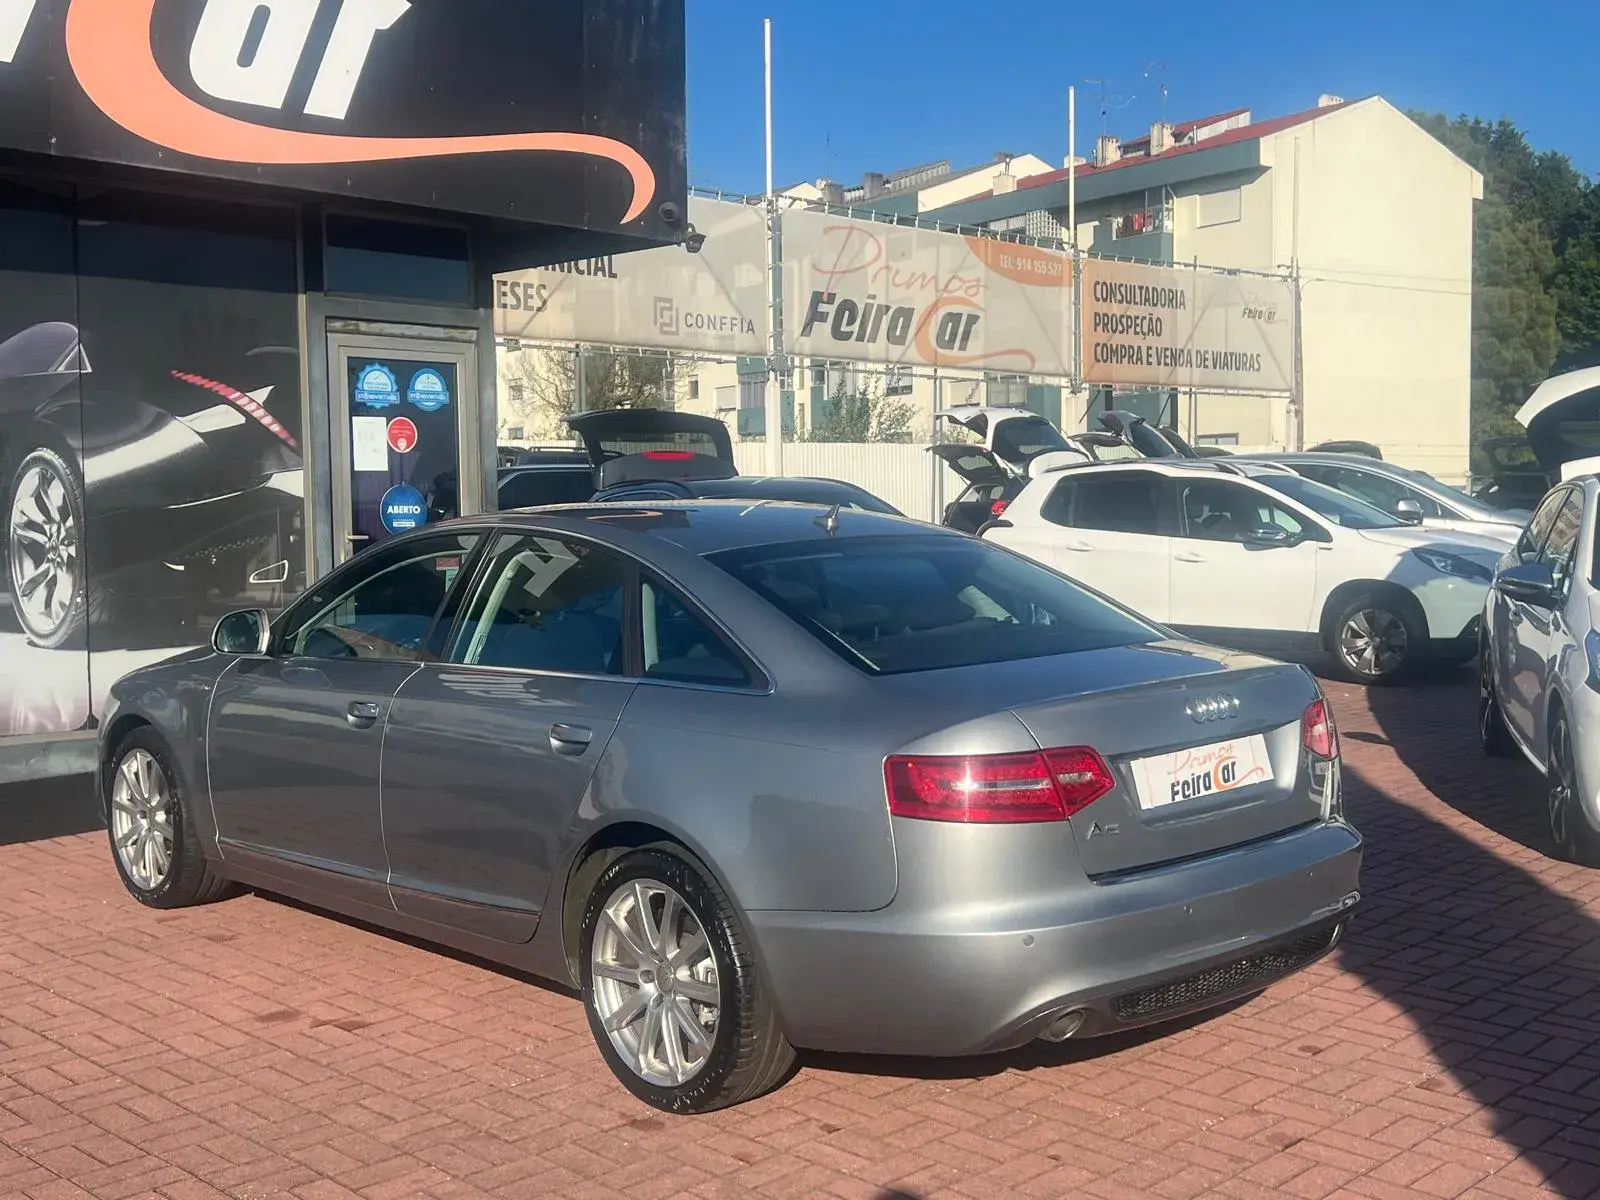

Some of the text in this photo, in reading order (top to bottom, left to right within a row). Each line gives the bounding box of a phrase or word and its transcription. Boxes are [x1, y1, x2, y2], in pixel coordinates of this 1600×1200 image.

[813, 225, 988, 300] Primos
[1093, 281, 1186, 310] CONSULTADORIA
[684, 313, 756, 335] CONFFIA
[1093, 312, 1163, 340] PROSPEÇÃO
[1094, 343, 1261, 372] COMPRA E VENDA DE VIATURAS
[387, 505, 421, 515] ABERTO
